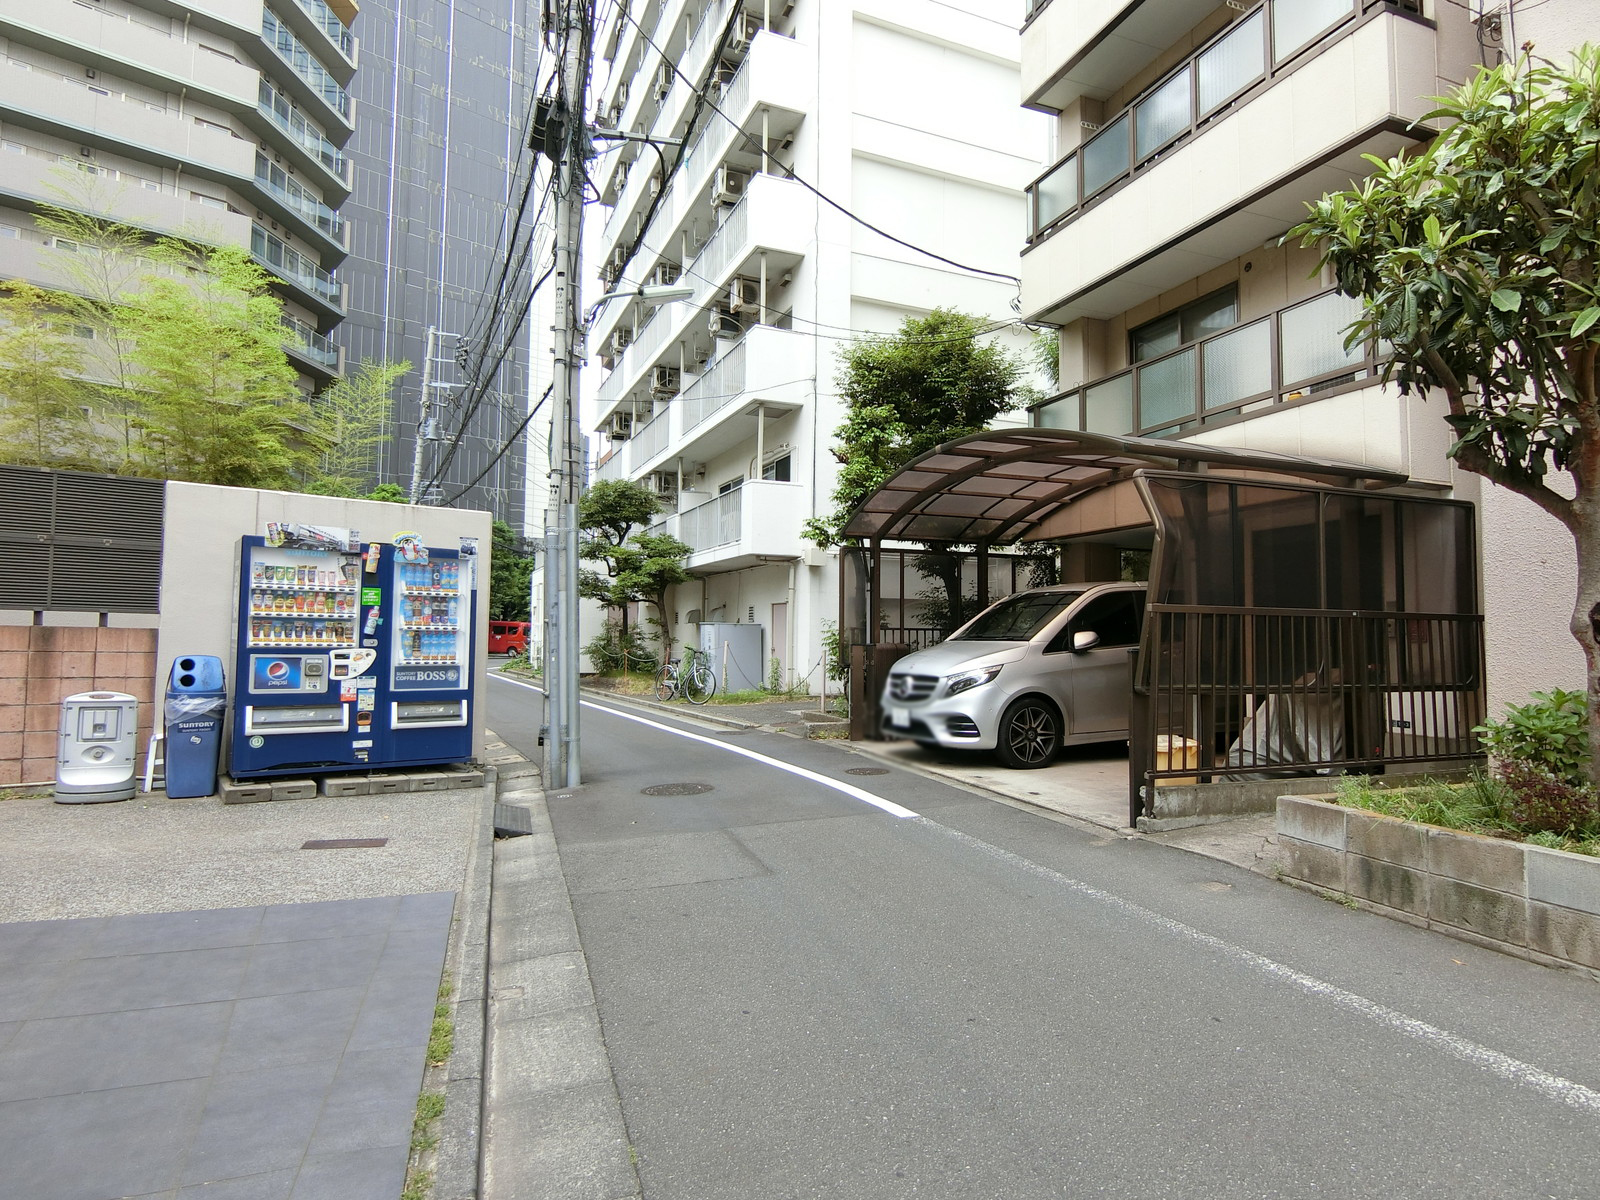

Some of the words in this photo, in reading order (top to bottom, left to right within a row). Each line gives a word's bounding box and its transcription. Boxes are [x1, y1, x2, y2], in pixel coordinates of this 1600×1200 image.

[417, 671, 446, 681] BOSS
[268, 679, 288, 687] pepsi
[178, 721, 215, 729] SUNTORY
